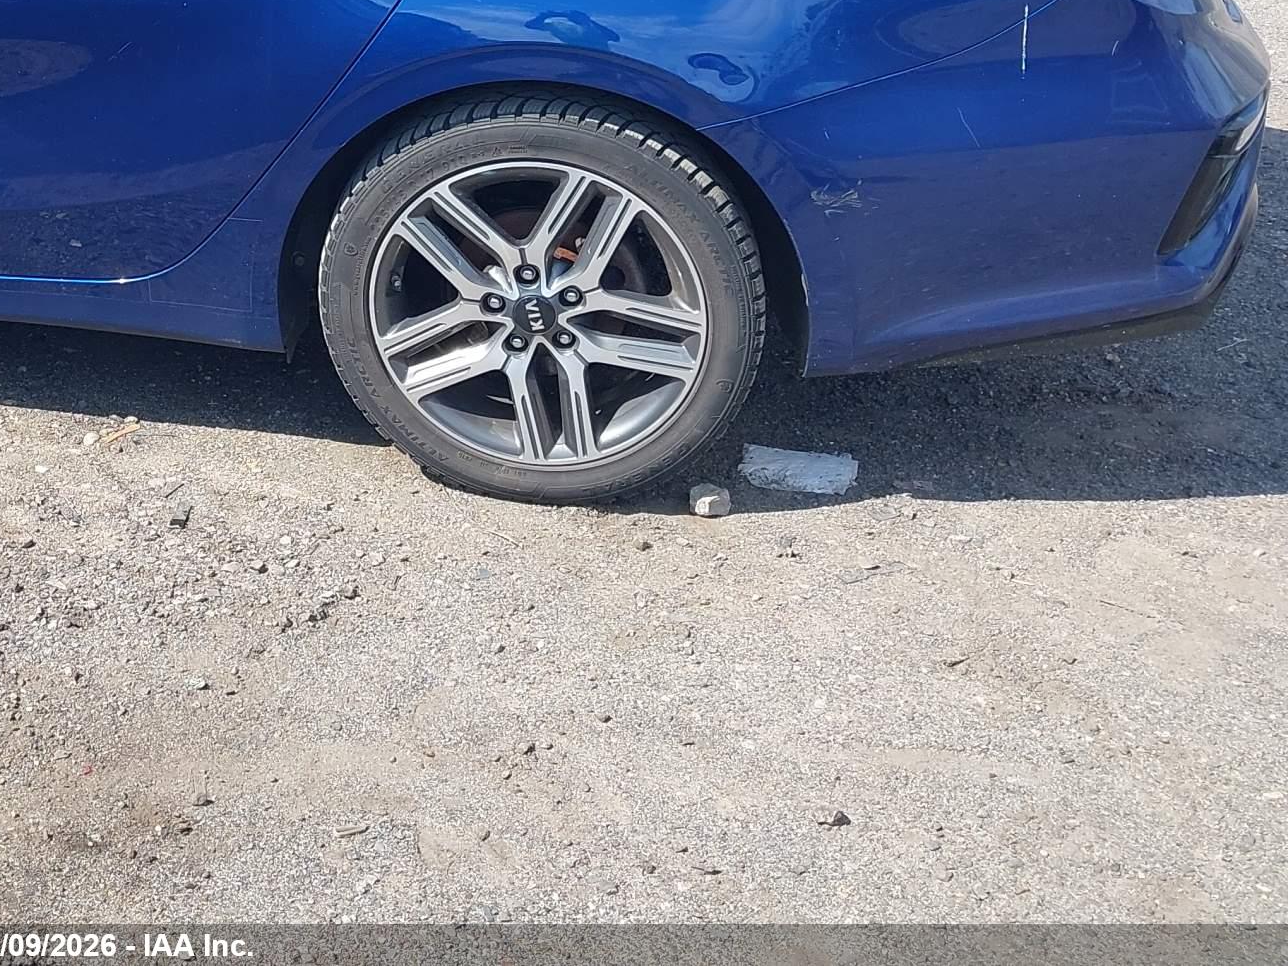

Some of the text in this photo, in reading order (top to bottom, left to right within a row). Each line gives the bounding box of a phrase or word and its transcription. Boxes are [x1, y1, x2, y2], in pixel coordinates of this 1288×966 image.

[525, 298, 545, 331] KIA
[346, 337, 383, 399] ARCTIC
[379, 403, 450, 463] ALTIMAX
